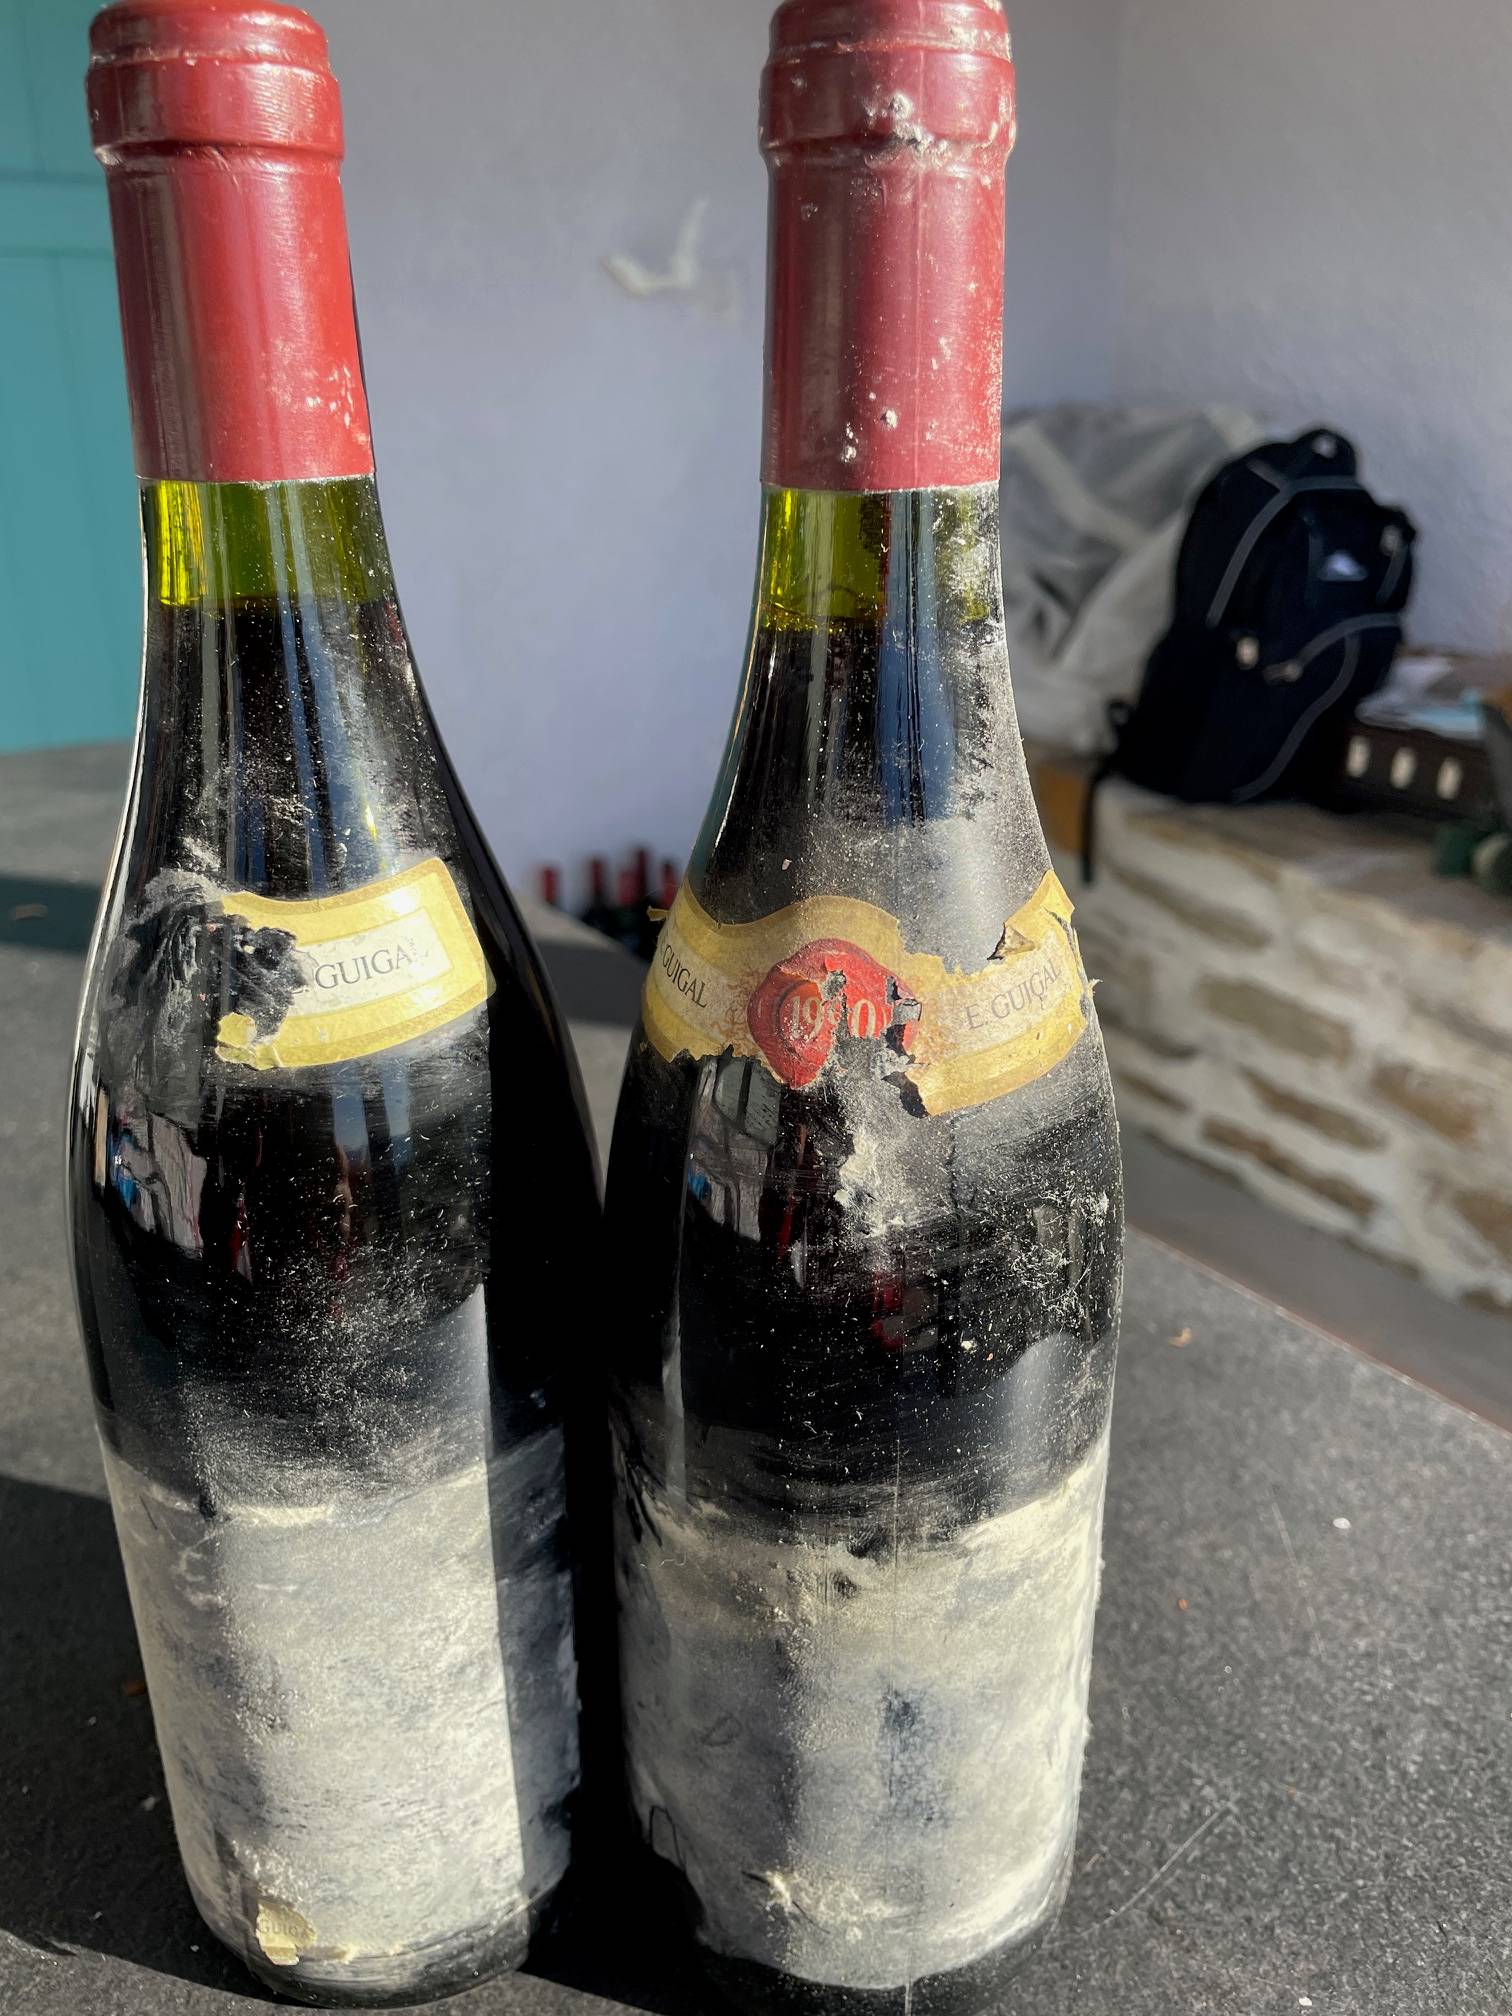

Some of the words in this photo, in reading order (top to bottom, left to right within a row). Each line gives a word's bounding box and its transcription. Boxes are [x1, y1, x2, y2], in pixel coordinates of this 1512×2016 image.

[314, 938, 429, 989] GUIGA
[662, 944, 708, 1008] GUIGAL
[991, 958, 1062, 1019] GUIGAL
